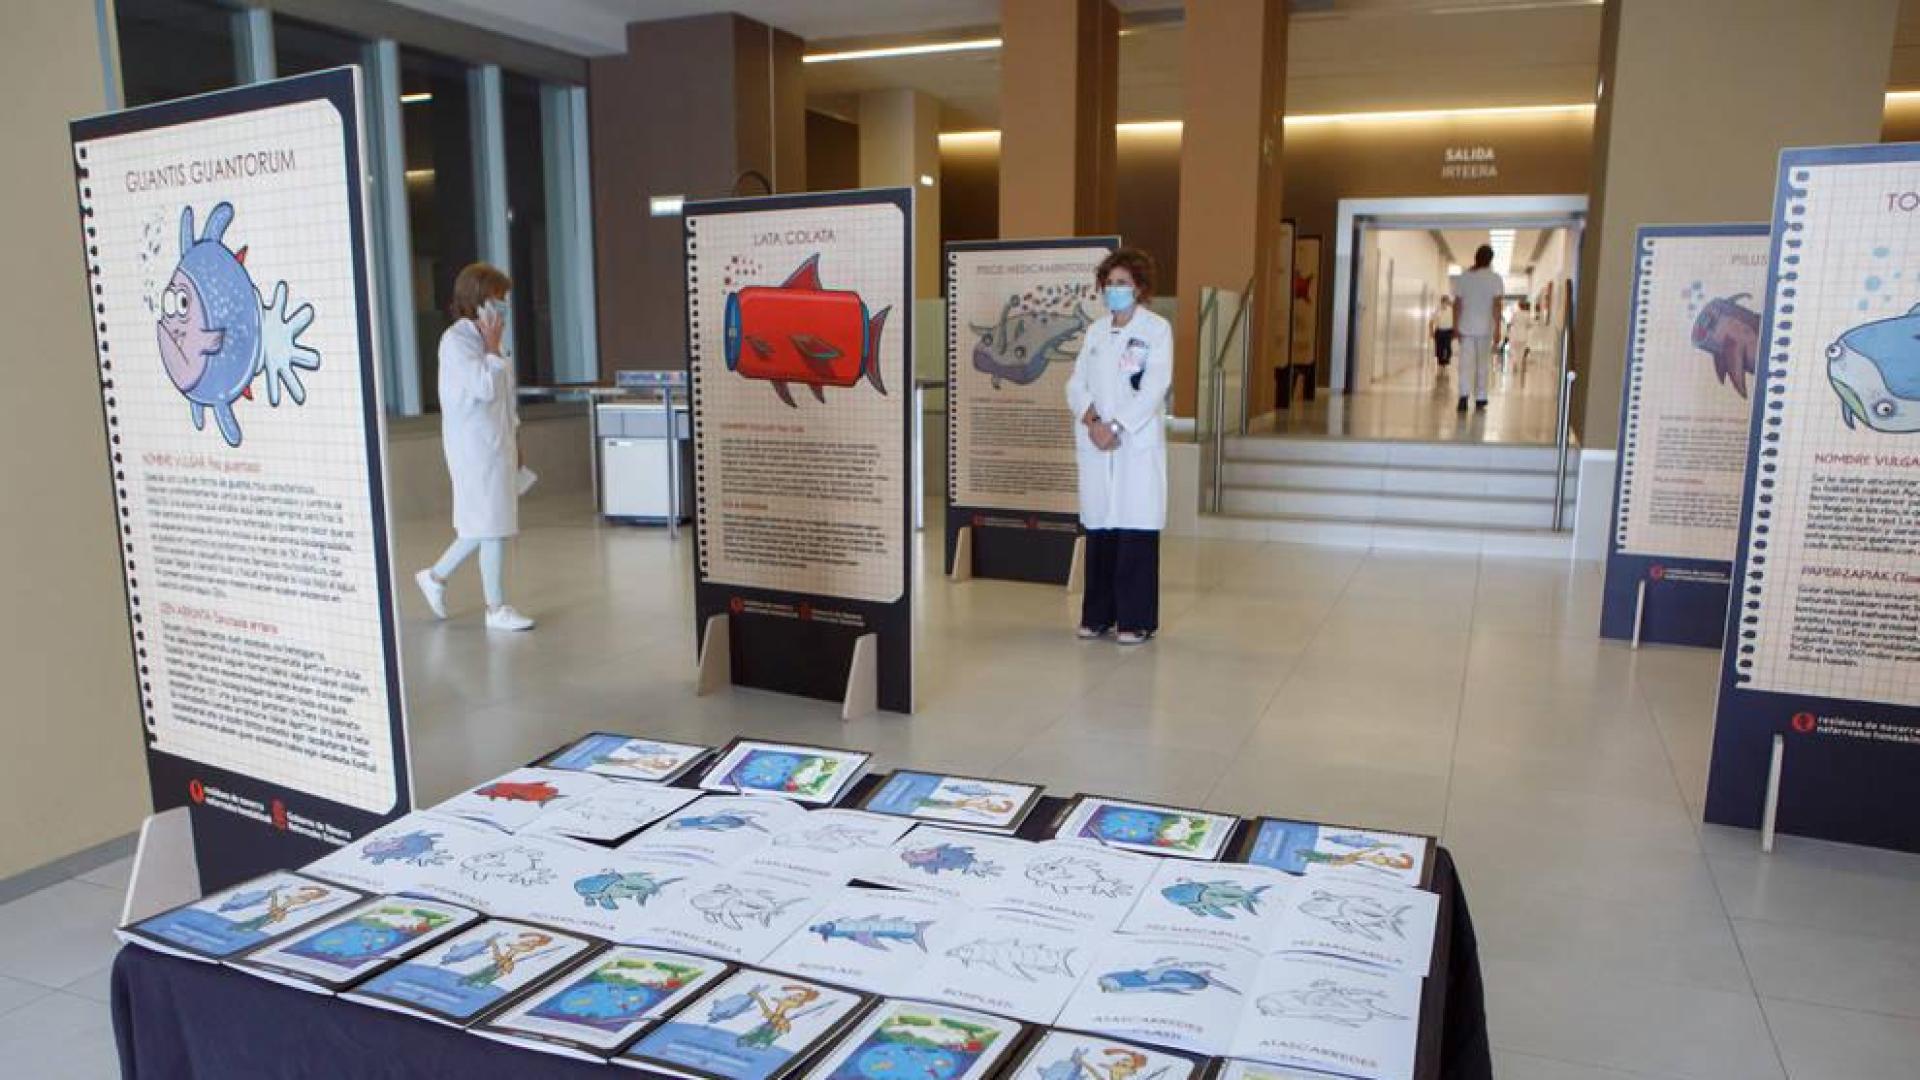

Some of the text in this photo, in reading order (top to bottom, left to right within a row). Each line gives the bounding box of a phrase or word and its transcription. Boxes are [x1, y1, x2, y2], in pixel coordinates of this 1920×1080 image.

[1445, 147, 1496, 162] SALIDA
[125, 150, 297, 193] GUANTIS GUANTORUM
[1442, 164, 1498, 179] IRTEERA
[754, 228, 836, 247] LATA COLATA
[1815, 453, 1870, 465] NOMBRE
[1865, 721, 1878, 730] de
